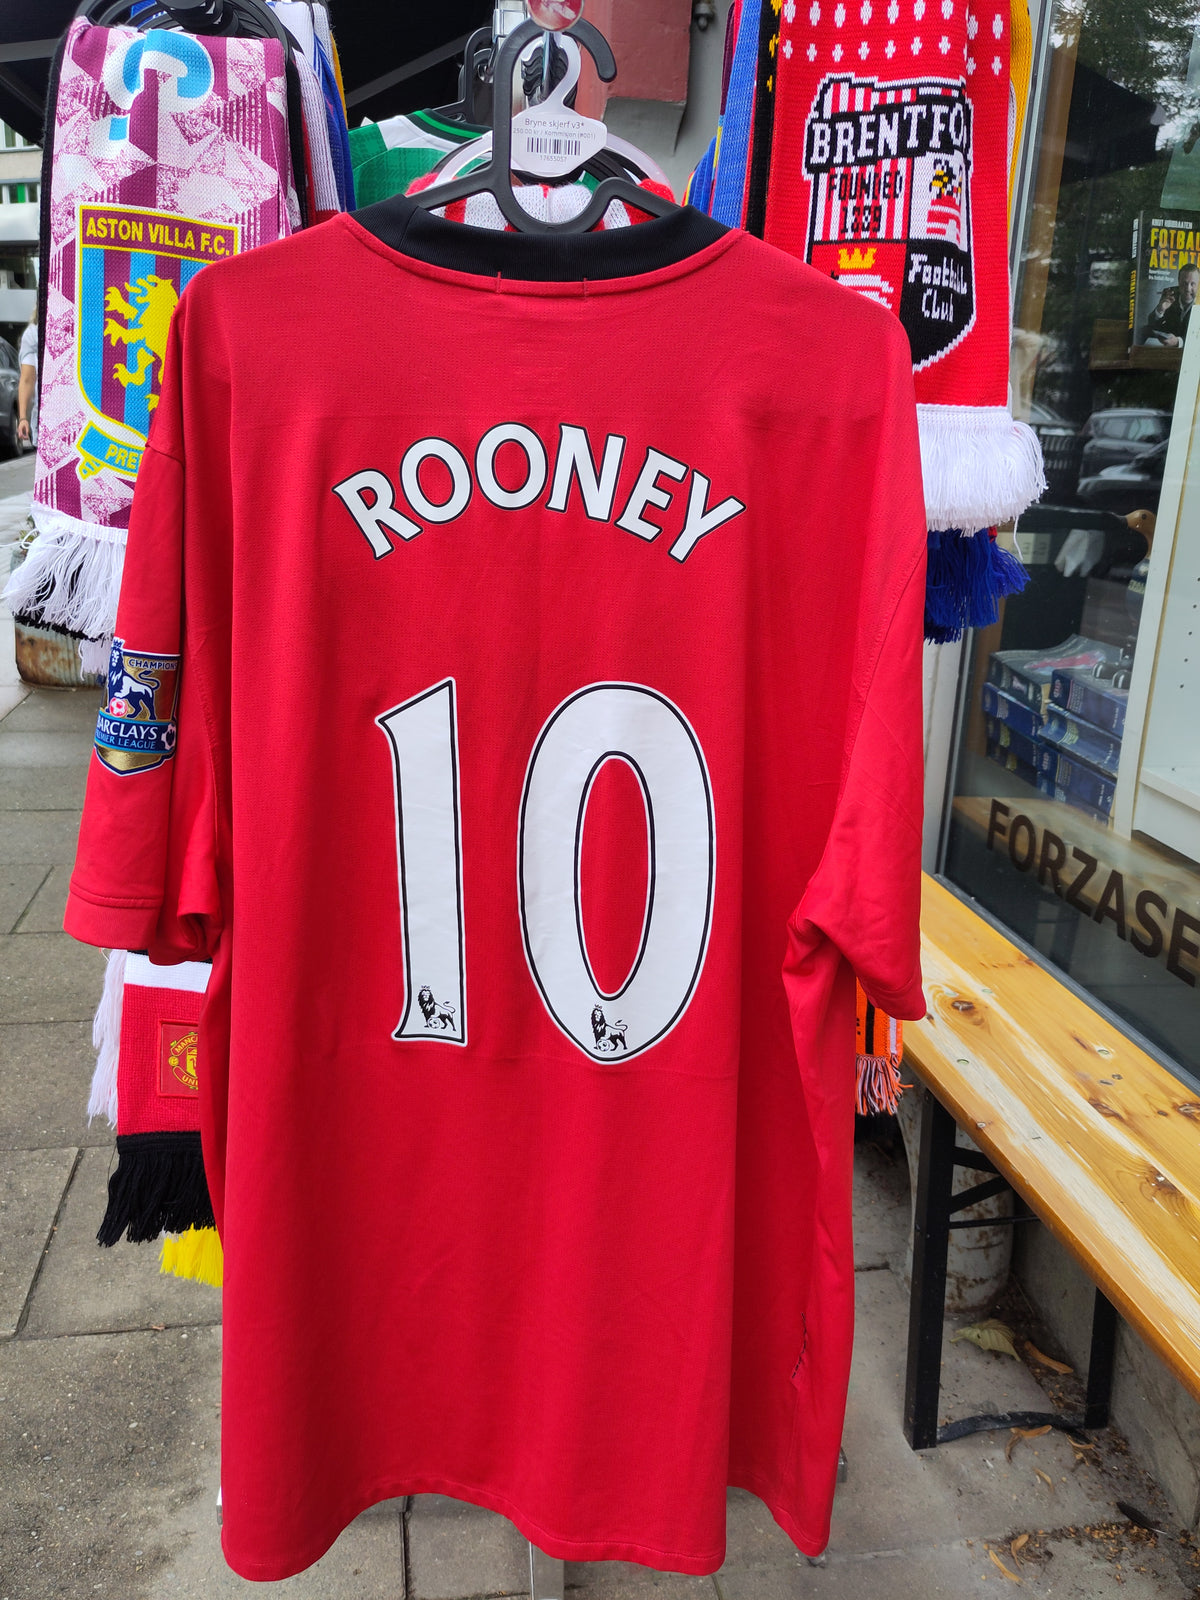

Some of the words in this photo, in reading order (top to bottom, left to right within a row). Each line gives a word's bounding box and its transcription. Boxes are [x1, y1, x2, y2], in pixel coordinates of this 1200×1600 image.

[524, 118, 547, 128] Bryne
[548, 120, 570, 130] skjerf
[544, 129, 576, 138] Kommisjon
[827, 170, 903, 202] FOUNDED
[840, 204, 883, 234] 1889
[86, 217, 143, 242] ASTON
[148, 223, 196, 250] VILLA
[200, 232, 230, 256] F.C.
[105, 444, 143, 470] PRE
[332, 422, 747, 563] ROONEY
[118, 738, 156, 749] LEAGUE
[374, 675, 717, 1065] 10
